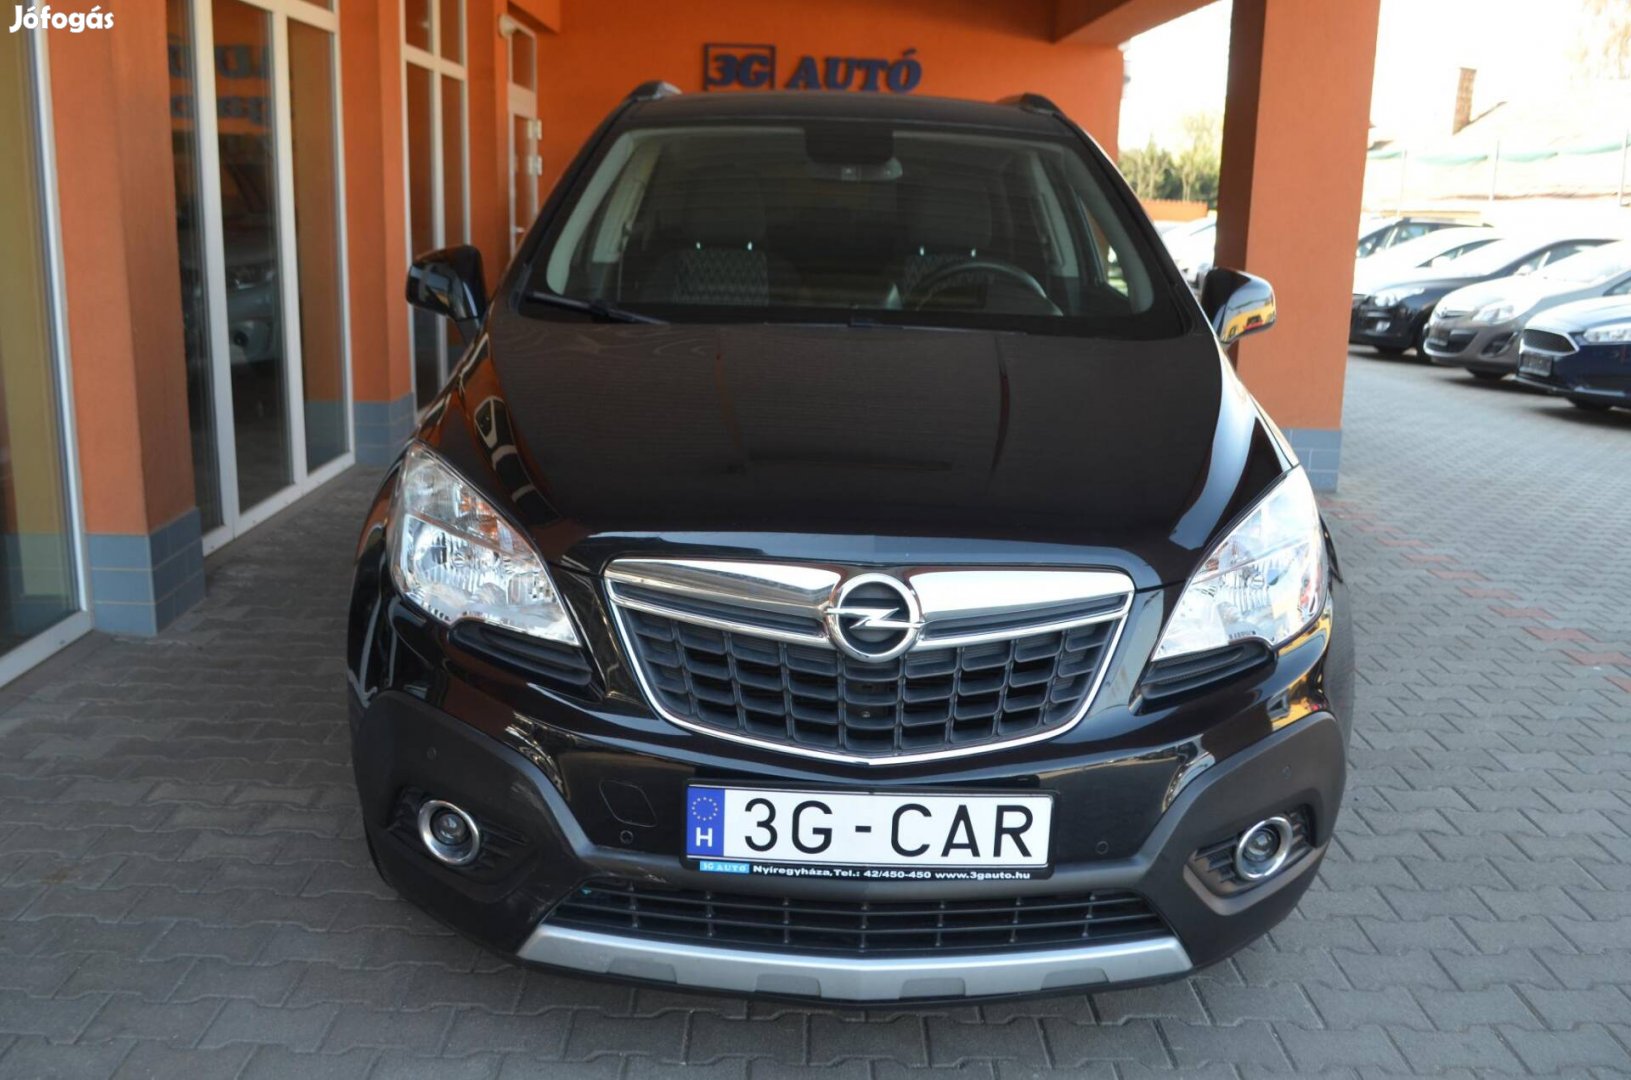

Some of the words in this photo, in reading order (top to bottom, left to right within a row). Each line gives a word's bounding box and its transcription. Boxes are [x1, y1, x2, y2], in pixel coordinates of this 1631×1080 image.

[707, 53, 770, 88] 3G
[785, 48, 923, 92] AUTÓ
[695, 827, 713, 848] H
[863, 870, 932, 879] 42/450-450
[935, 871, 1031, 881] www.3gauto.hu
